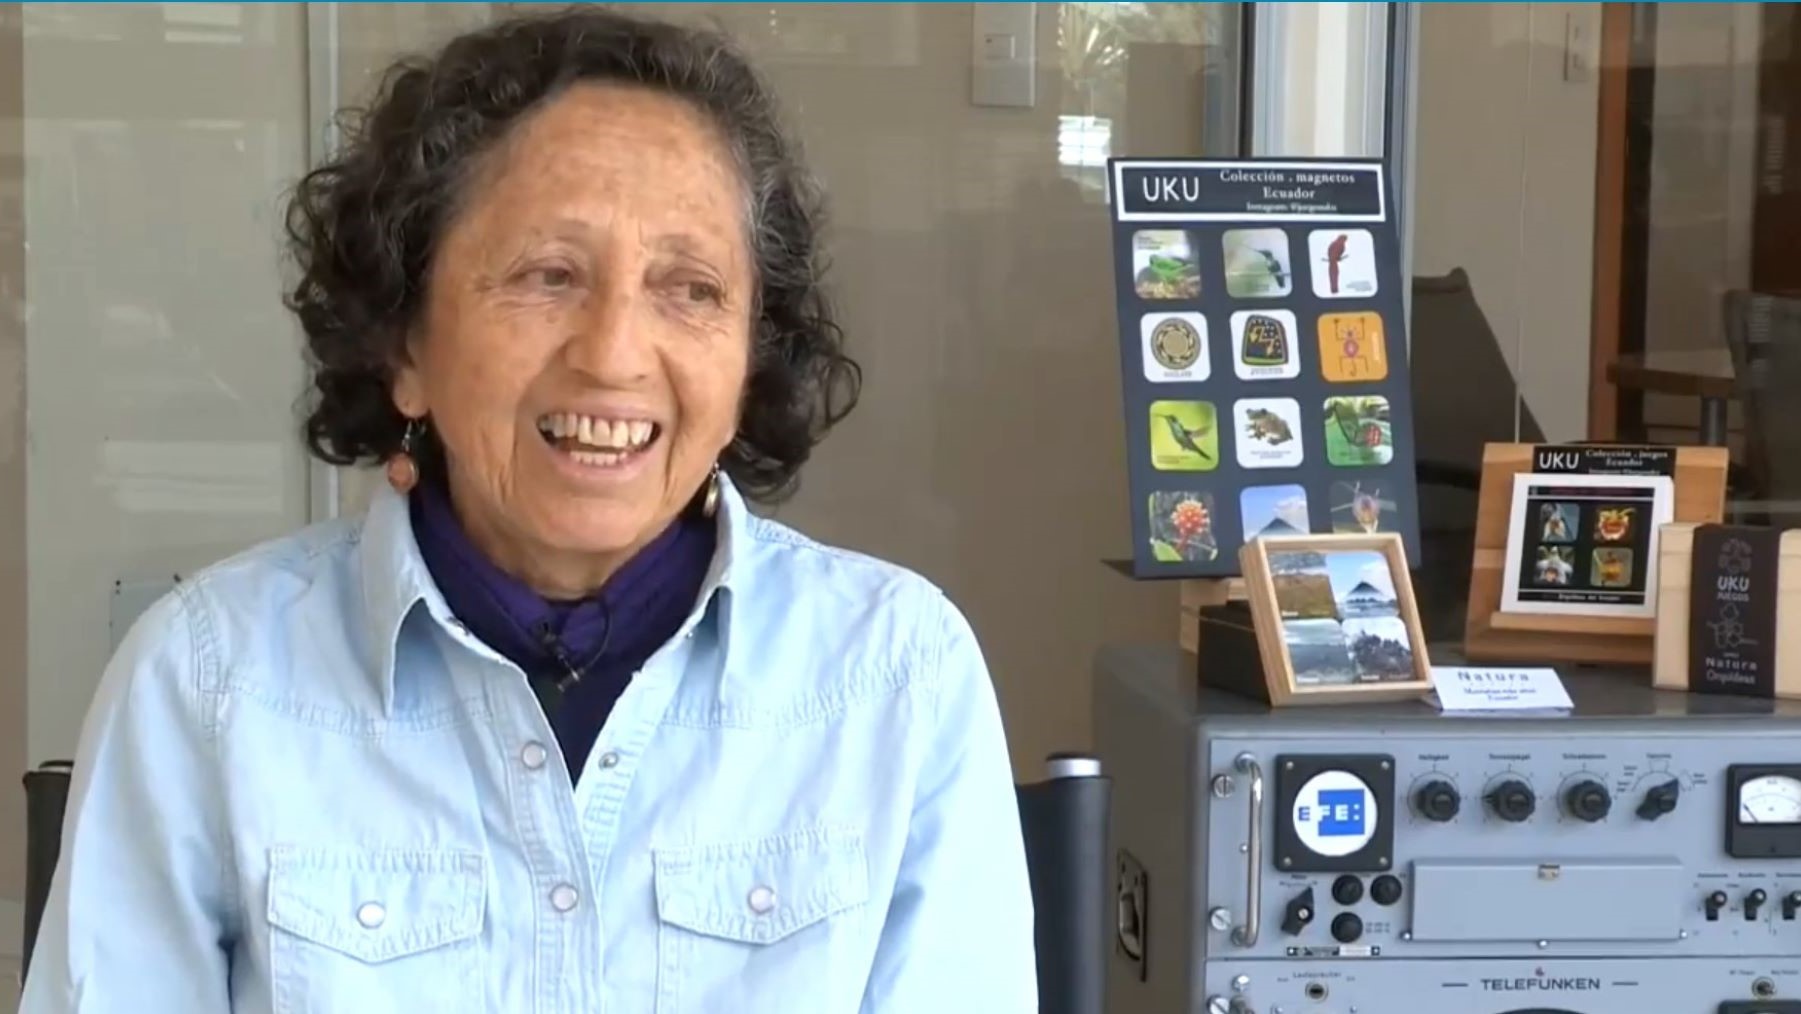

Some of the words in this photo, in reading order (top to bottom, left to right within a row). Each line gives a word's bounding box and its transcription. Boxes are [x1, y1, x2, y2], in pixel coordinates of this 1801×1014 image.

[1220, 169, 1284, 183] Colección
[1296, 172, 1356, 186] magnetos
[1143, 176, 1199, 202] UKU
[1263, 186, 1316, 199] Ecuador
[1539, 452, 1580, 469] UKU
[1717, 576, 1750, 592] UKU
[1705, 657, 1757, 671] Natura
[1481, 978, 1600, 991] TELEFUNKEN
